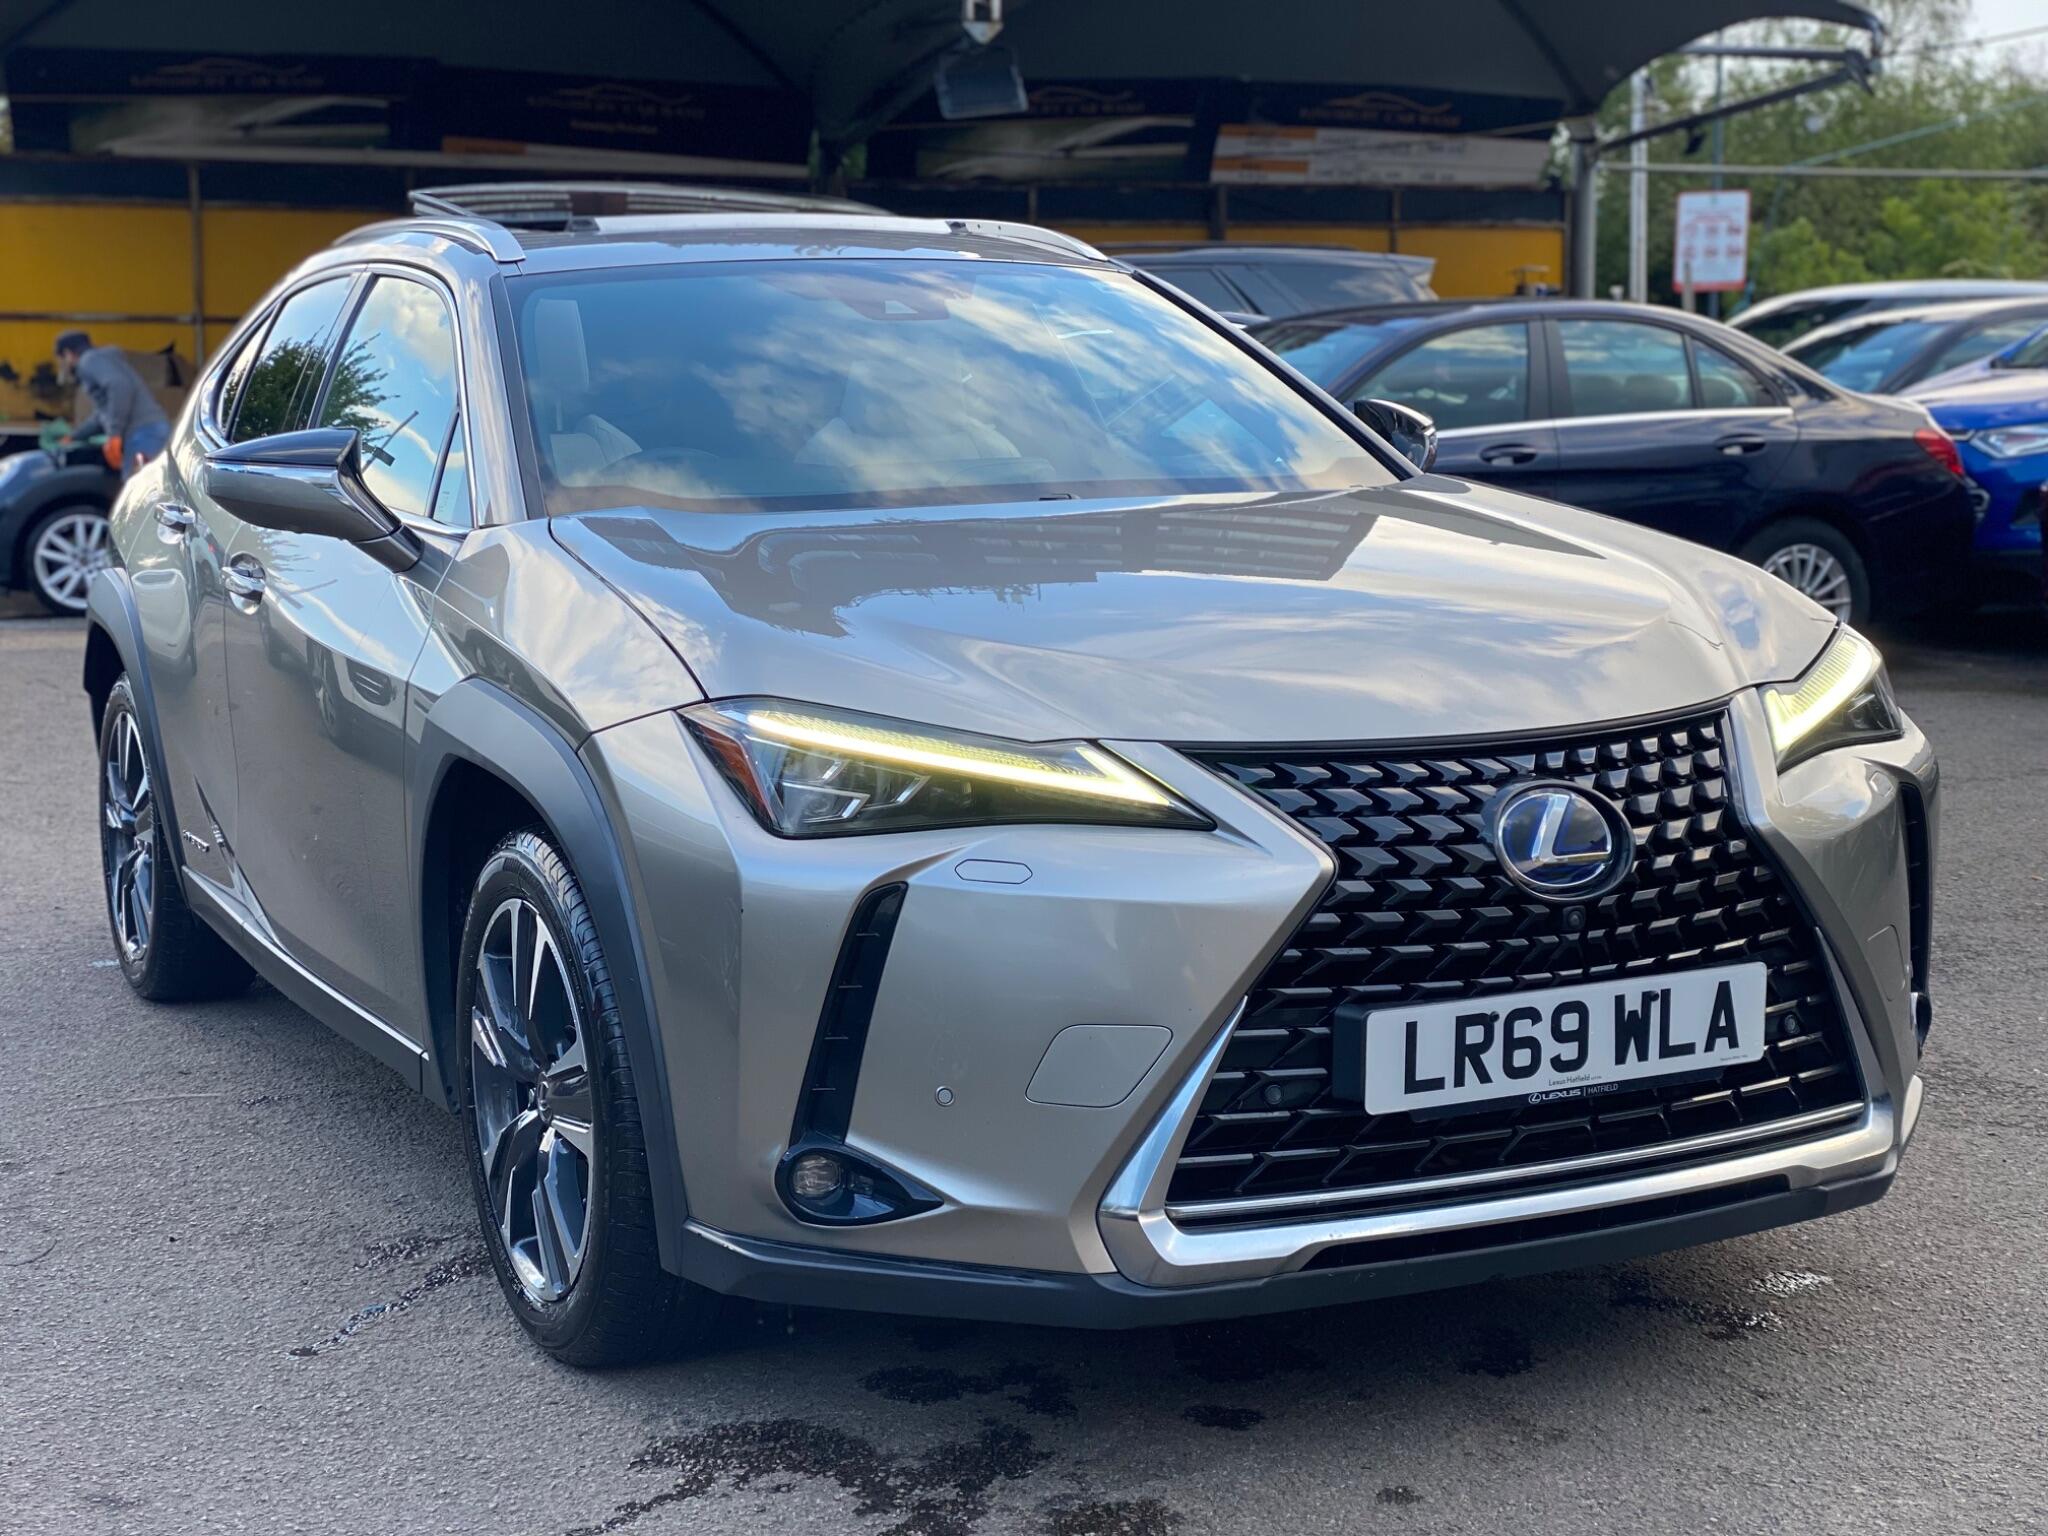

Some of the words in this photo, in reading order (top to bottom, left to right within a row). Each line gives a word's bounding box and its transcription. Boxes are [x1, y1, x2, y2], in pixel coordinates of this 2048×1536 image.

[1404, 1000, 1590, 1095] LR69
[1614, 980, 1740, 1067] WLA
[1548, 1078, 1566, 1087] Lexus
[1566, 1074, 1591, 1083] Hatfield
[1542, 1089, 1581, 1100] LEXUS
[1588, 1083, 1619, 1094] HATFIELD
